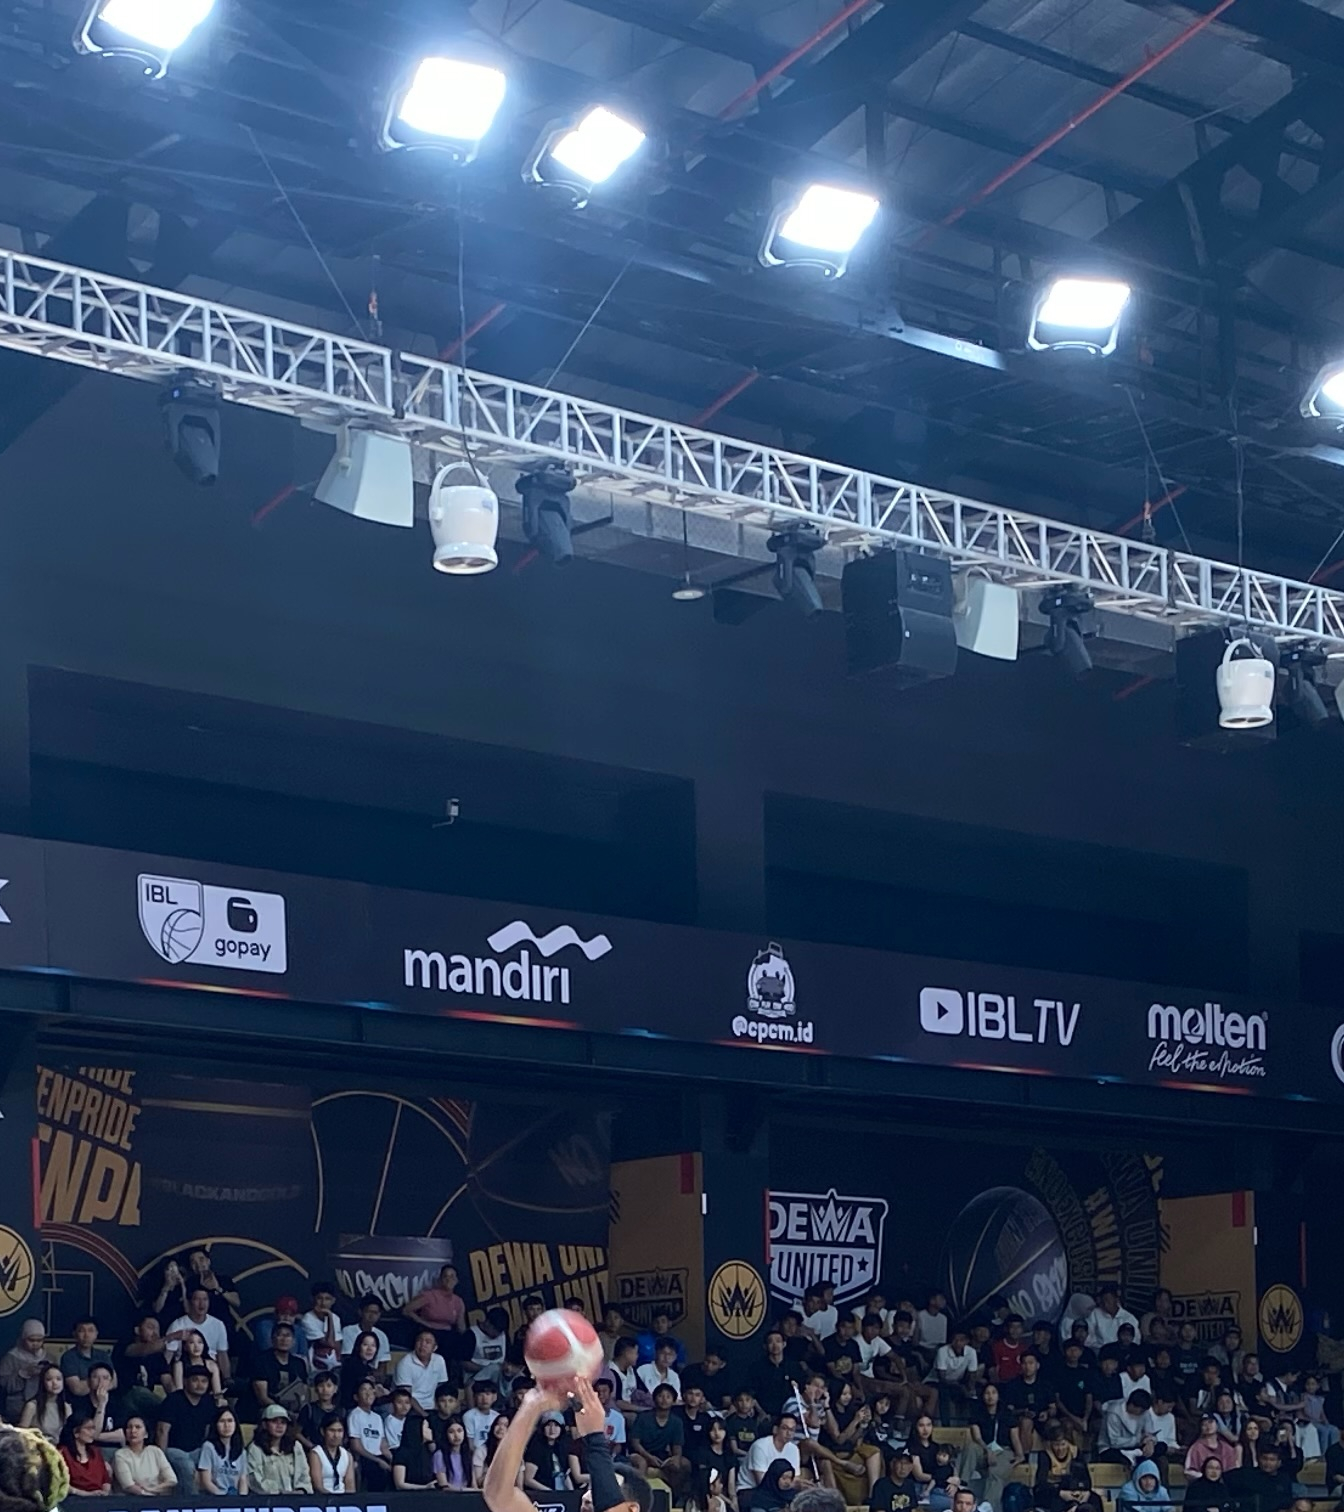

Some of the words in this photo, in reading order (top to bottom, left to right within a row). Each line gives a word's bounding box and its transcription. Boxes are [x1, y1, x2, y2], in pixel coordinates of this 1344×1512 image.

[145, 884, 179, 905] IBL
[214, 938, 272, 962] gopay
[404, 949, 570, 1004] mandiri
[1148, 1003, 1267, 1051] molten
[769, 1199, 875, 1244] DEWA
[469, 1241, 554, 1303] DEWA
[777, 1252, 855, 1289] UNITED
